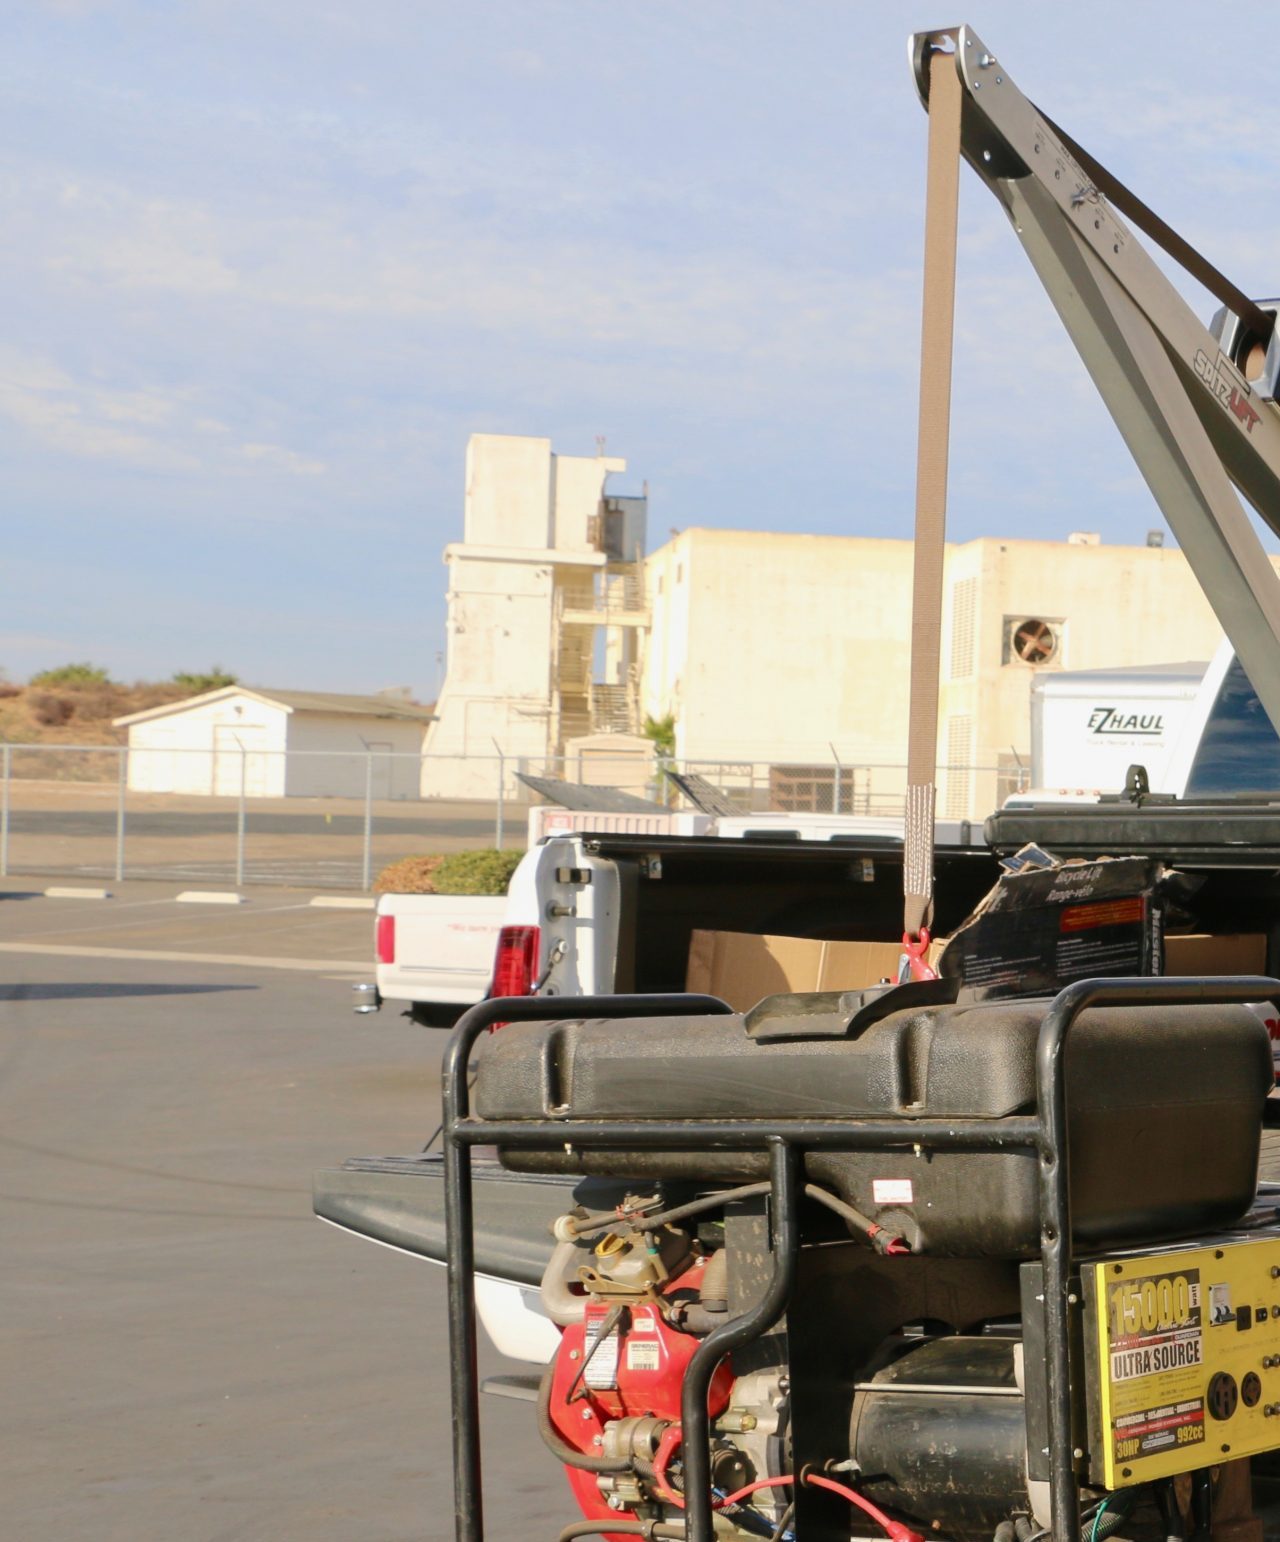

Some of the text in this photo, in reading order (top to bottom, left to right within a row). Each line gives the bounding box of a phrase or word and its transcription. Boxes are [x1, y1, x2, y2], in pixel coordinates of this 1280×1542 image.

[1111, 1276, 1189, 1336] 15000
[1114, 1350, 1151, 1379] ULTRA
[1153, 1340, 1200, 1370] SOURCE
